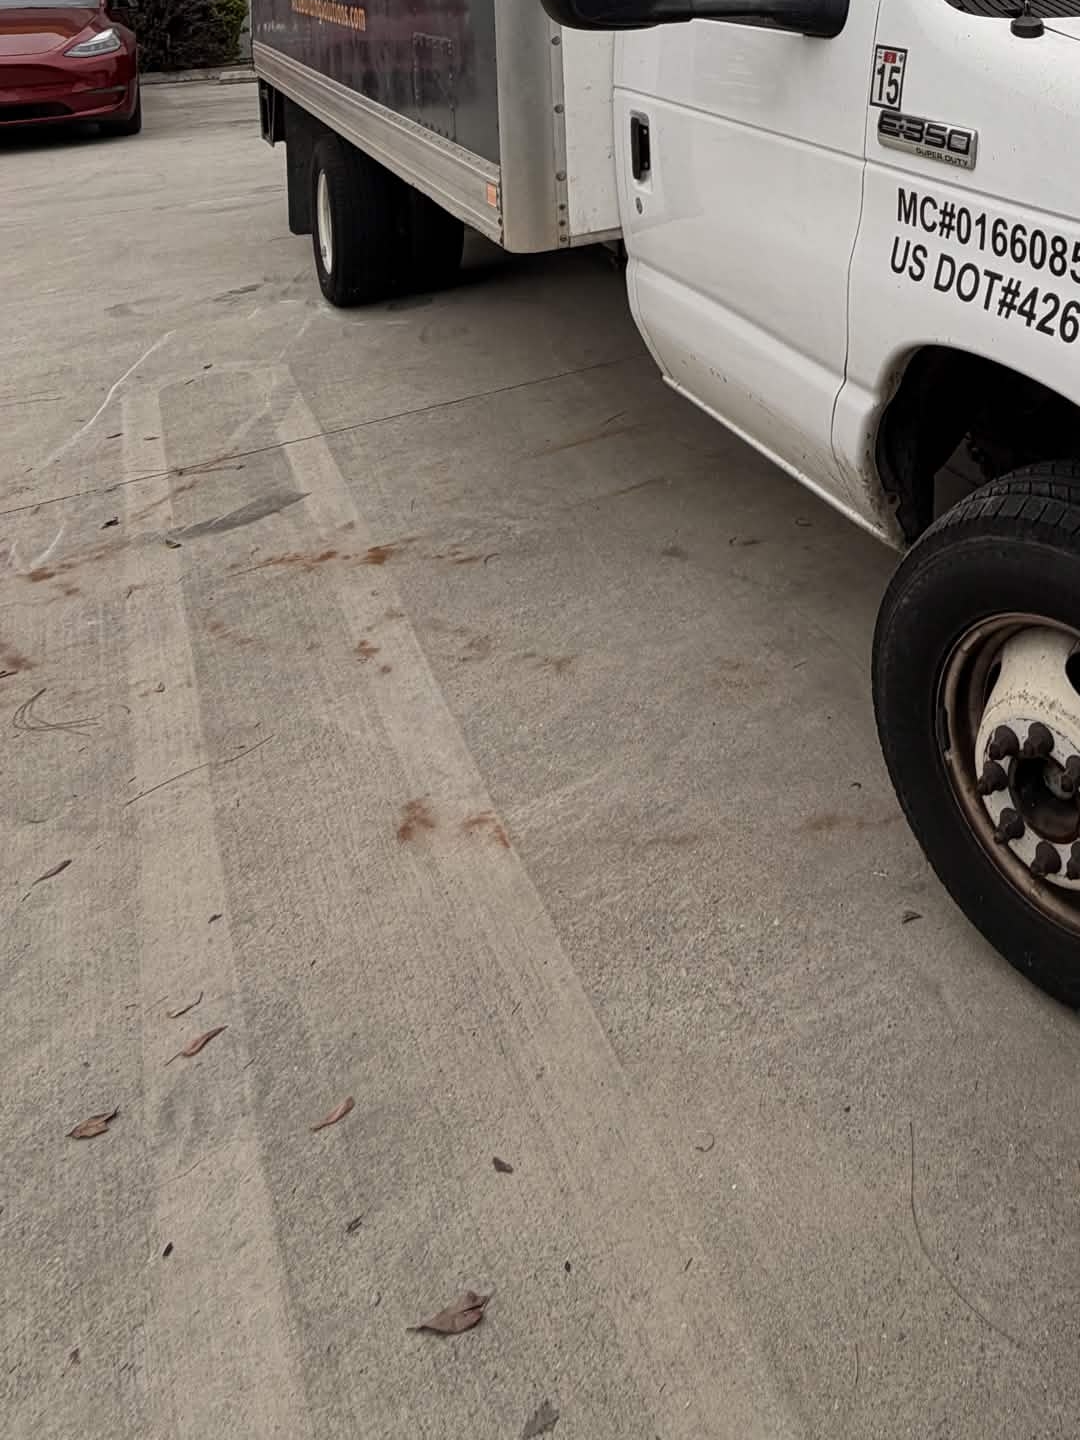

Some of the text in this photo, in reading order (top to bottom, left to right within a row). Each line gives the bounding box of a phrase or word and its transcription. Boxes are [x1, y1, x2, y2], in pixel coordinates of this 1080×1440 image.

[877, 64, 901, 105] 15
[916, 147, 969, 167] SUPER DUTY
[890, 236, 928, 282] US
